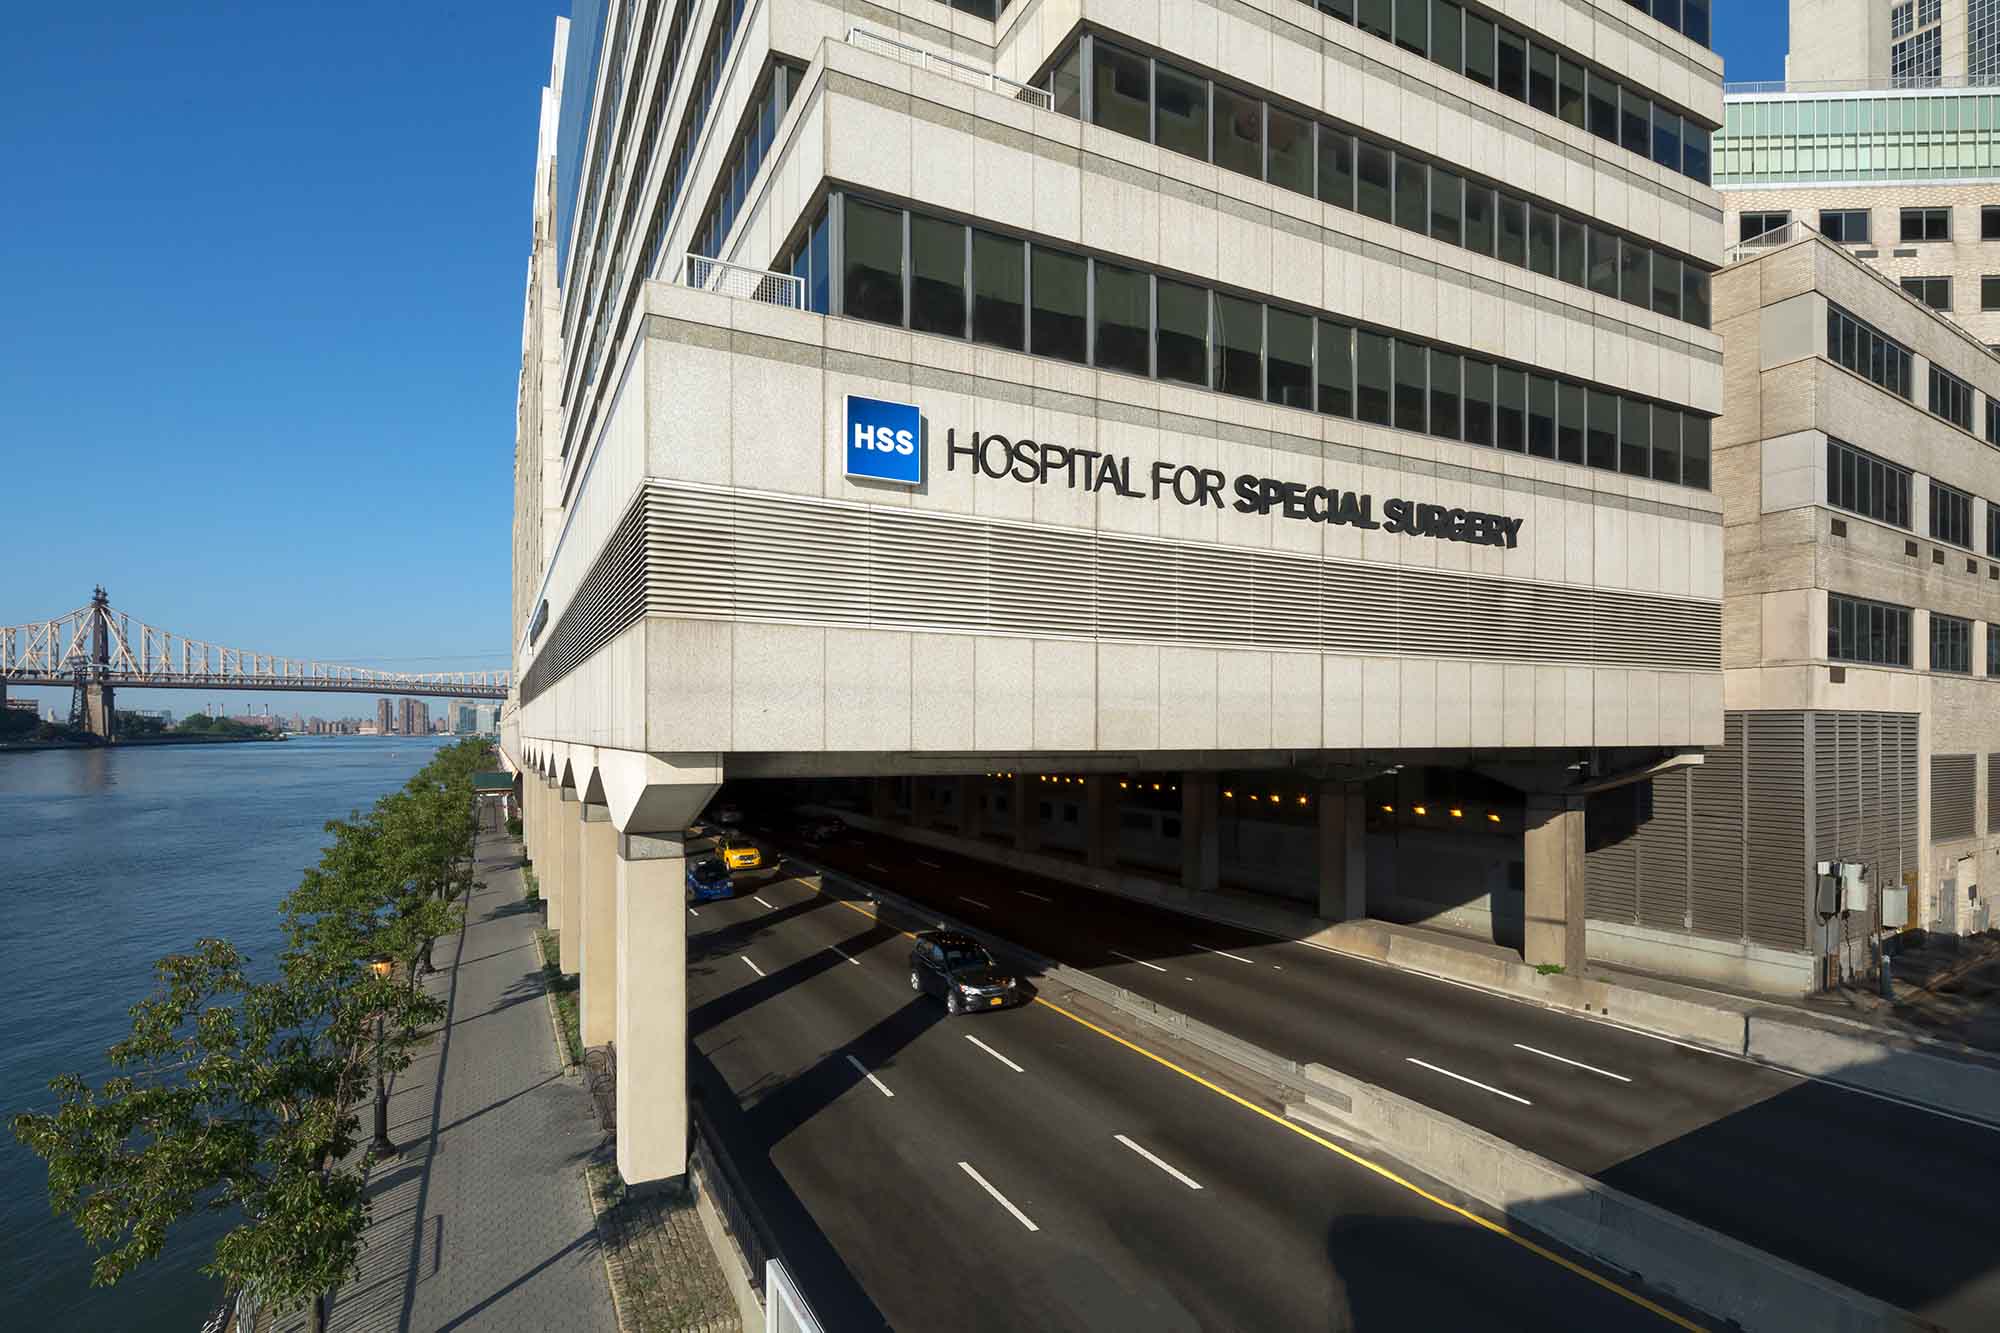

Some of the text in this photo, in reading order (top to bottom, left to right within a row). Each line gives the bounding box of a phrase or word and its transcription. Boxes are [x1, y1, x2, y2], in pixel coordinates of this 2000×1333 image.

[855, 423, 914, 455] HSS
[947, 428, 1524, 550] HOSPITAL FOR SPECIAL SURGERY
